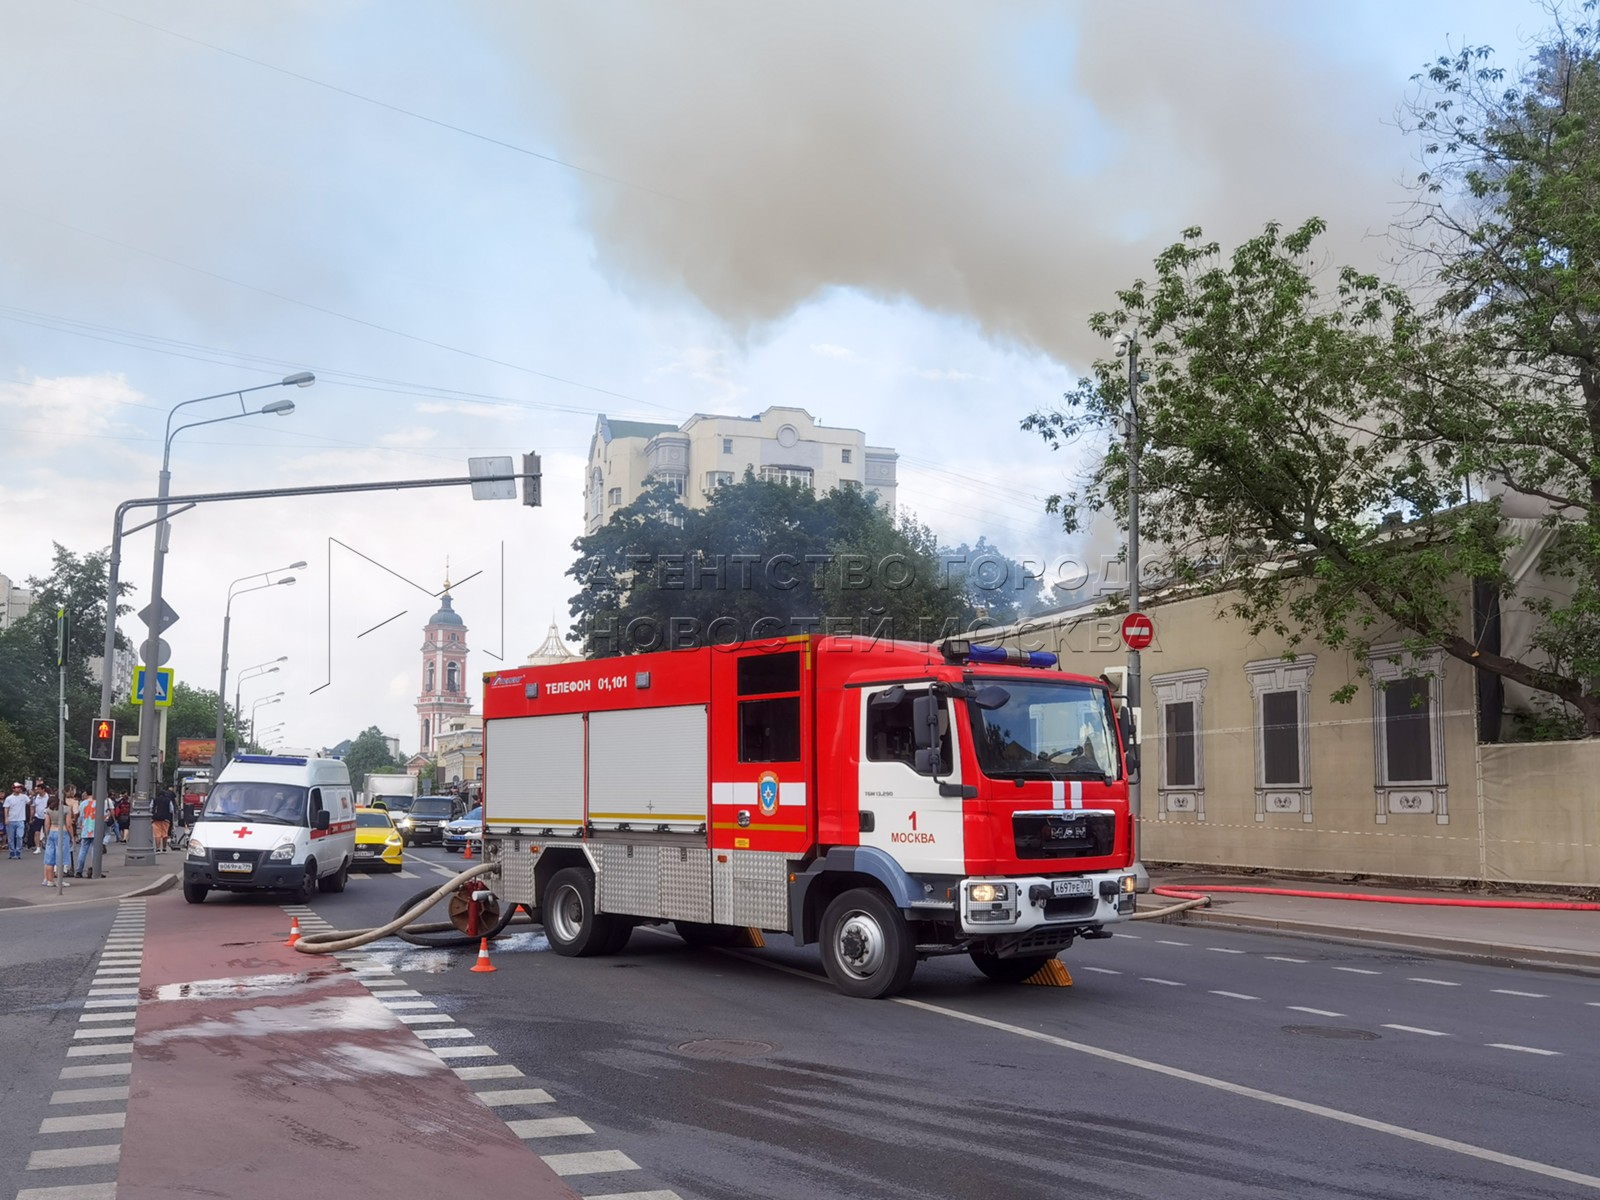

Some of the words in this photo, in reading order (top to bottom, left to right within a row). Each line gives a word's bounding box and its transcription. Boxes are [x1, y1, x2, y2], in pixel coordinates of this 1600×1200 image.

[545, 680, 591, 695] ТЕЛЕФОН
[598, 675, 627, 692] 01,101
[908, 811, 917, 831] 1
[891, 833, 935, 843] МОСКВА
[1051, 827, 1086, 839] MAN
